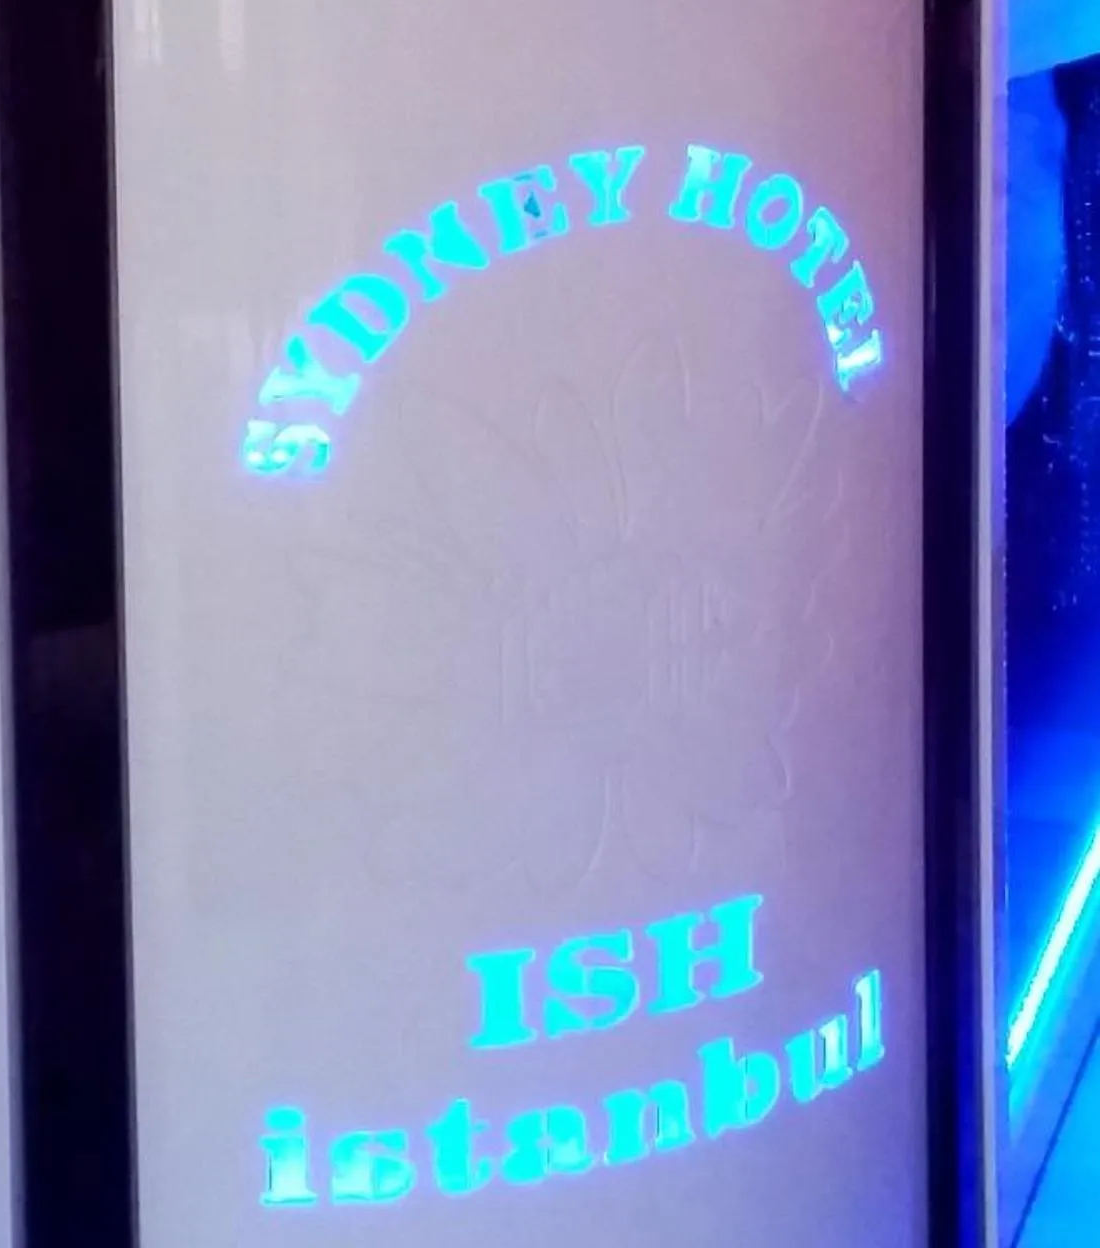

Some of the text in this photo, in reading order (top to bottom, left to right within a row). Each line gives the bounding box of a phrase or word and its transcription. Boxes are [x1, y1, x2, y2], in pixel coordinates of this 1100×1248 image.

[240, 143, 883, 475] SYDNEY HOTEL
[256, 968, 886, 1208] istanbul
[464, 893, 764, 1050] ISH
